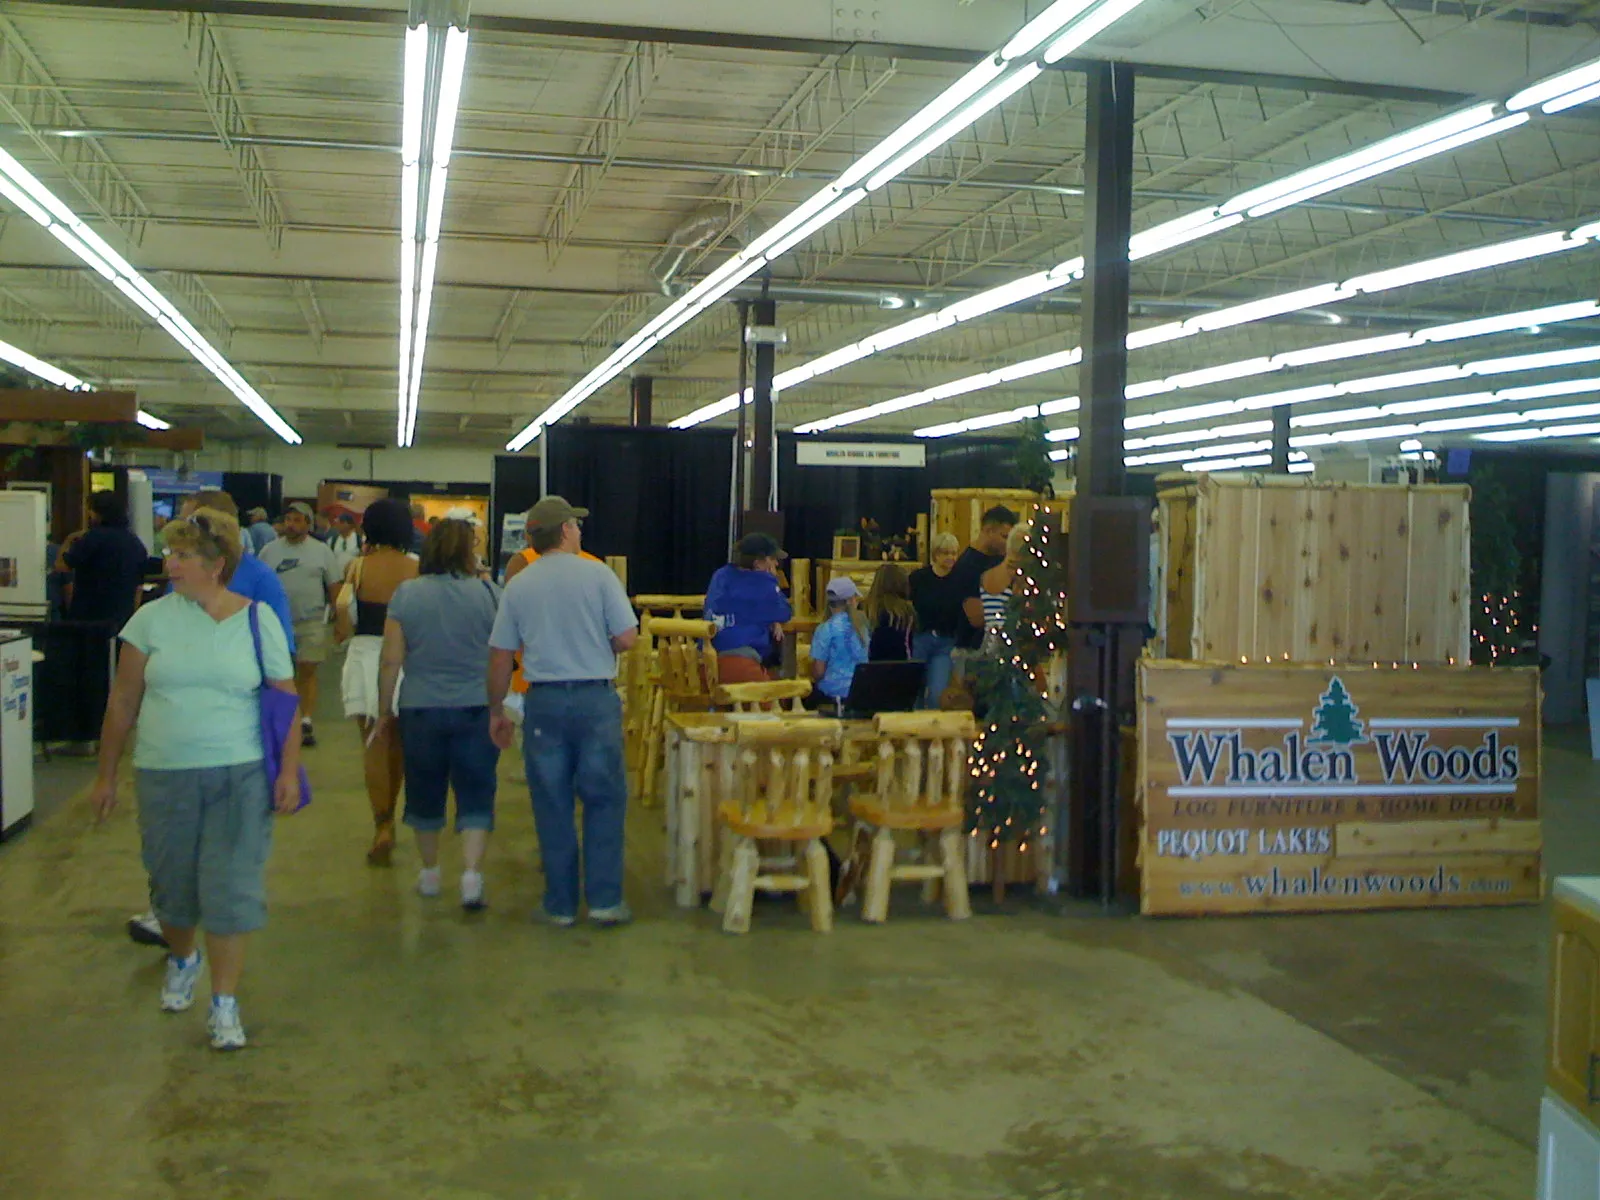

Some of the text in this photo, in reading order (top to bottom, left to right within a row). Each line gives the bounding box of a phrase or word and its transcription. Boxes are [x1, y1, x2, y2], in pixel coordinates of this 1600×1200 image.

[1166, 727, 1520, 785] Whalen Woods
[1173, 801, 1217, 818] LOG
[1227, 799, 1347, 818] FURNITURE
[1379, 798, 1440, 816] HOME
[1449, 796, 1520, 814] DECOR
[1157, 827, 1331, 860] PEQUOT LAKES
